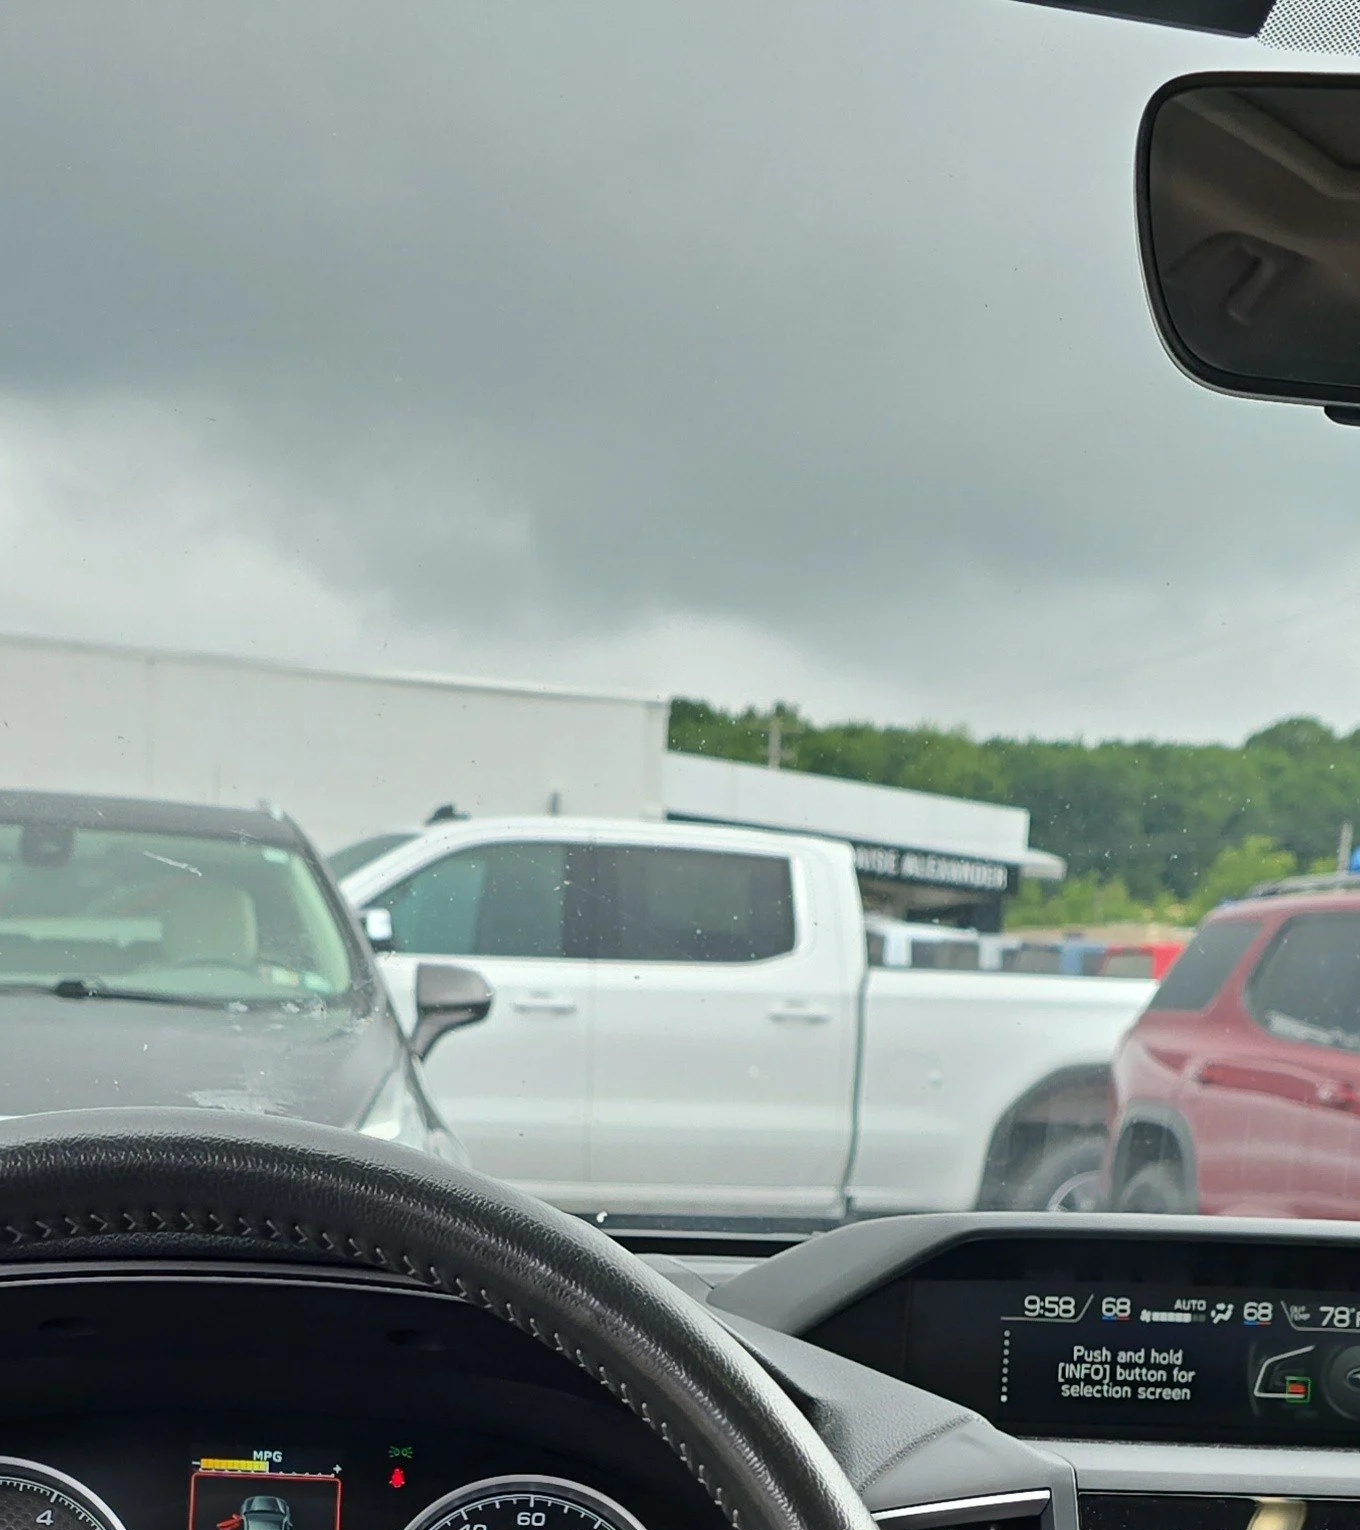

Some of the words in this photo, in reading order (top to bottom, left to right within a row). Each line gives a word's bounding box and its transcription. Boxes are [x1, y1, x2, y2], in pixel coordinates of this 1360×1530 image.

[1024, 1295, 1076, 1318] 9:58
[1101, 1297, 1131, 1317] 68
[1174, 1299, 1207, 1311] AUTO
[1243, 1302, 1273, 1322] 68
[1073, 1346, 1111, 1363] Push
[1117, 1349, 1147, 1364] and
[1150, 1349, 1183, 1364] hold
[1058, 1362, 1111, 1383] [INFO]
[1115, 1366, 1168, 1381] button
[1172, 1367, 1196, 1383] for
[1061, 1382, 1134, 1398] selection
[1138, 1386, 1191, 1400] screen
[253, 1450, 282, 1463] MPG
[36, 1510, 54, 1526] 4
[516, 1512, 546, 1526] 60
